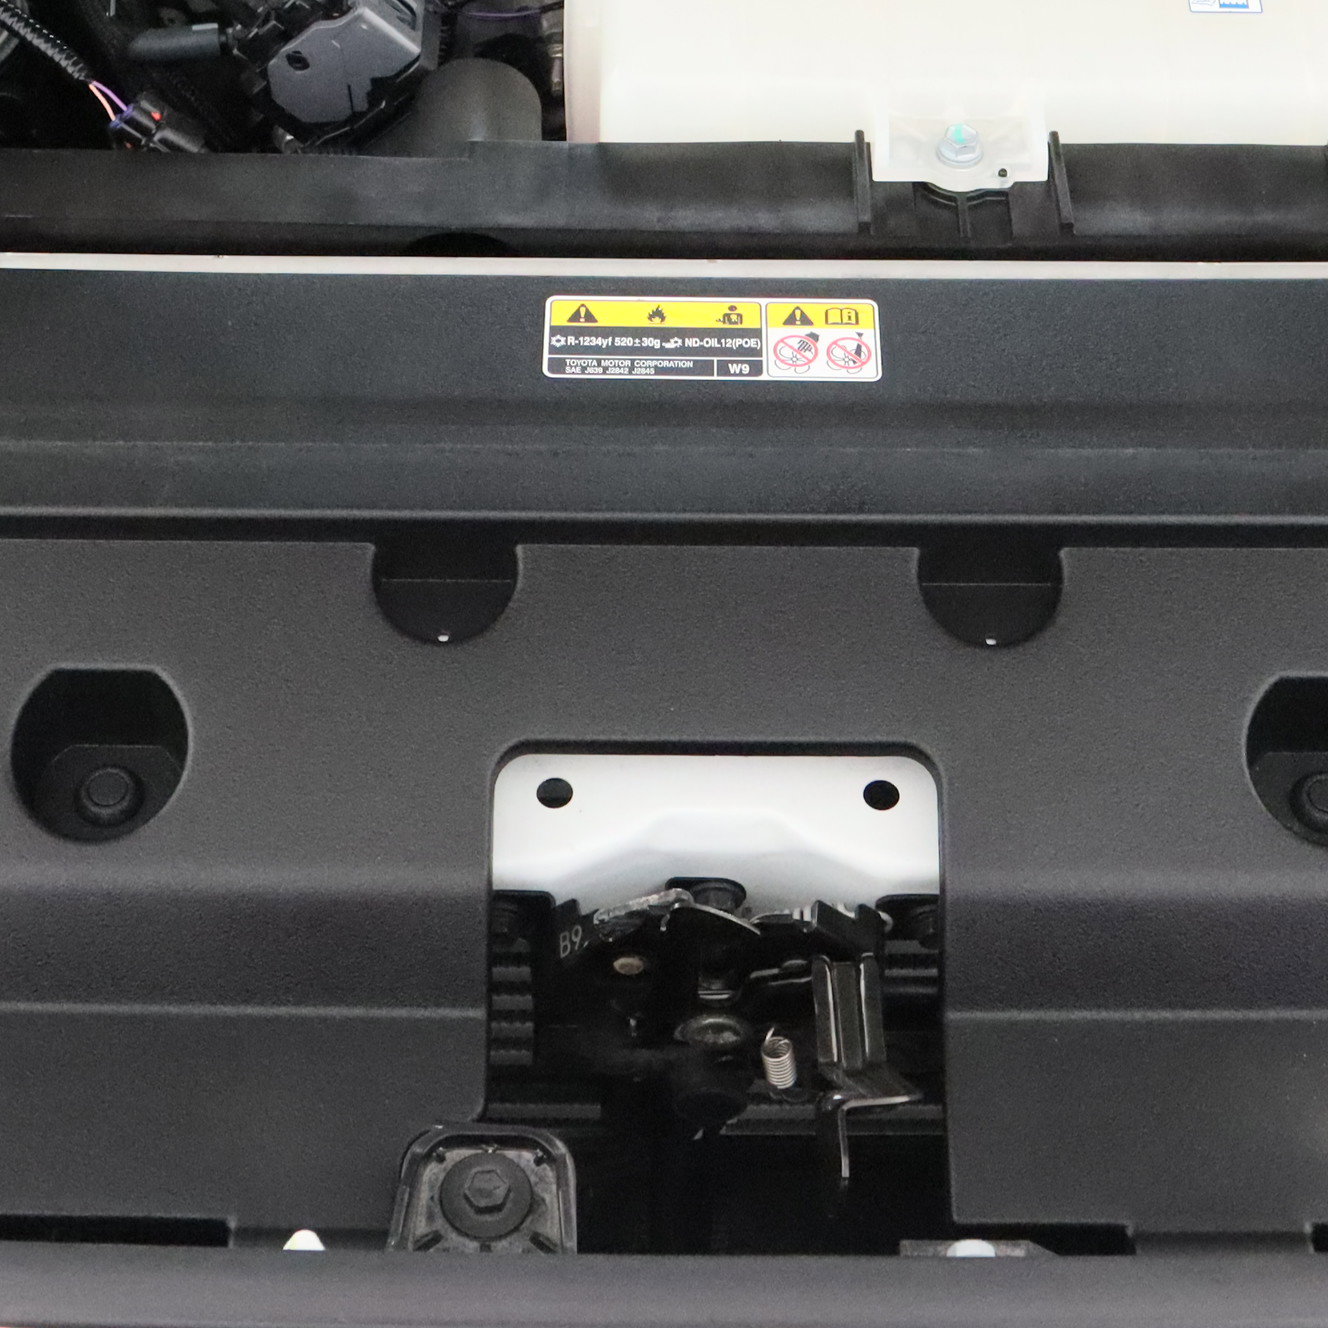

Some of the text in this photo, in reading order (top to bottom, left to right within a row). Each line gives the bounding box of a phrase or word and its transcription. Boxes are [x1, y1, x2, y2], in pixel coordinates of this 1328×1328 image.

[567, 336, 761, 350] R-1234yf 520±30g ND-OIL12(POE)
[565, 359, 693, 368] TOYOTA MOTOR CORPORATION
[728, 363, 750, 374] W9
